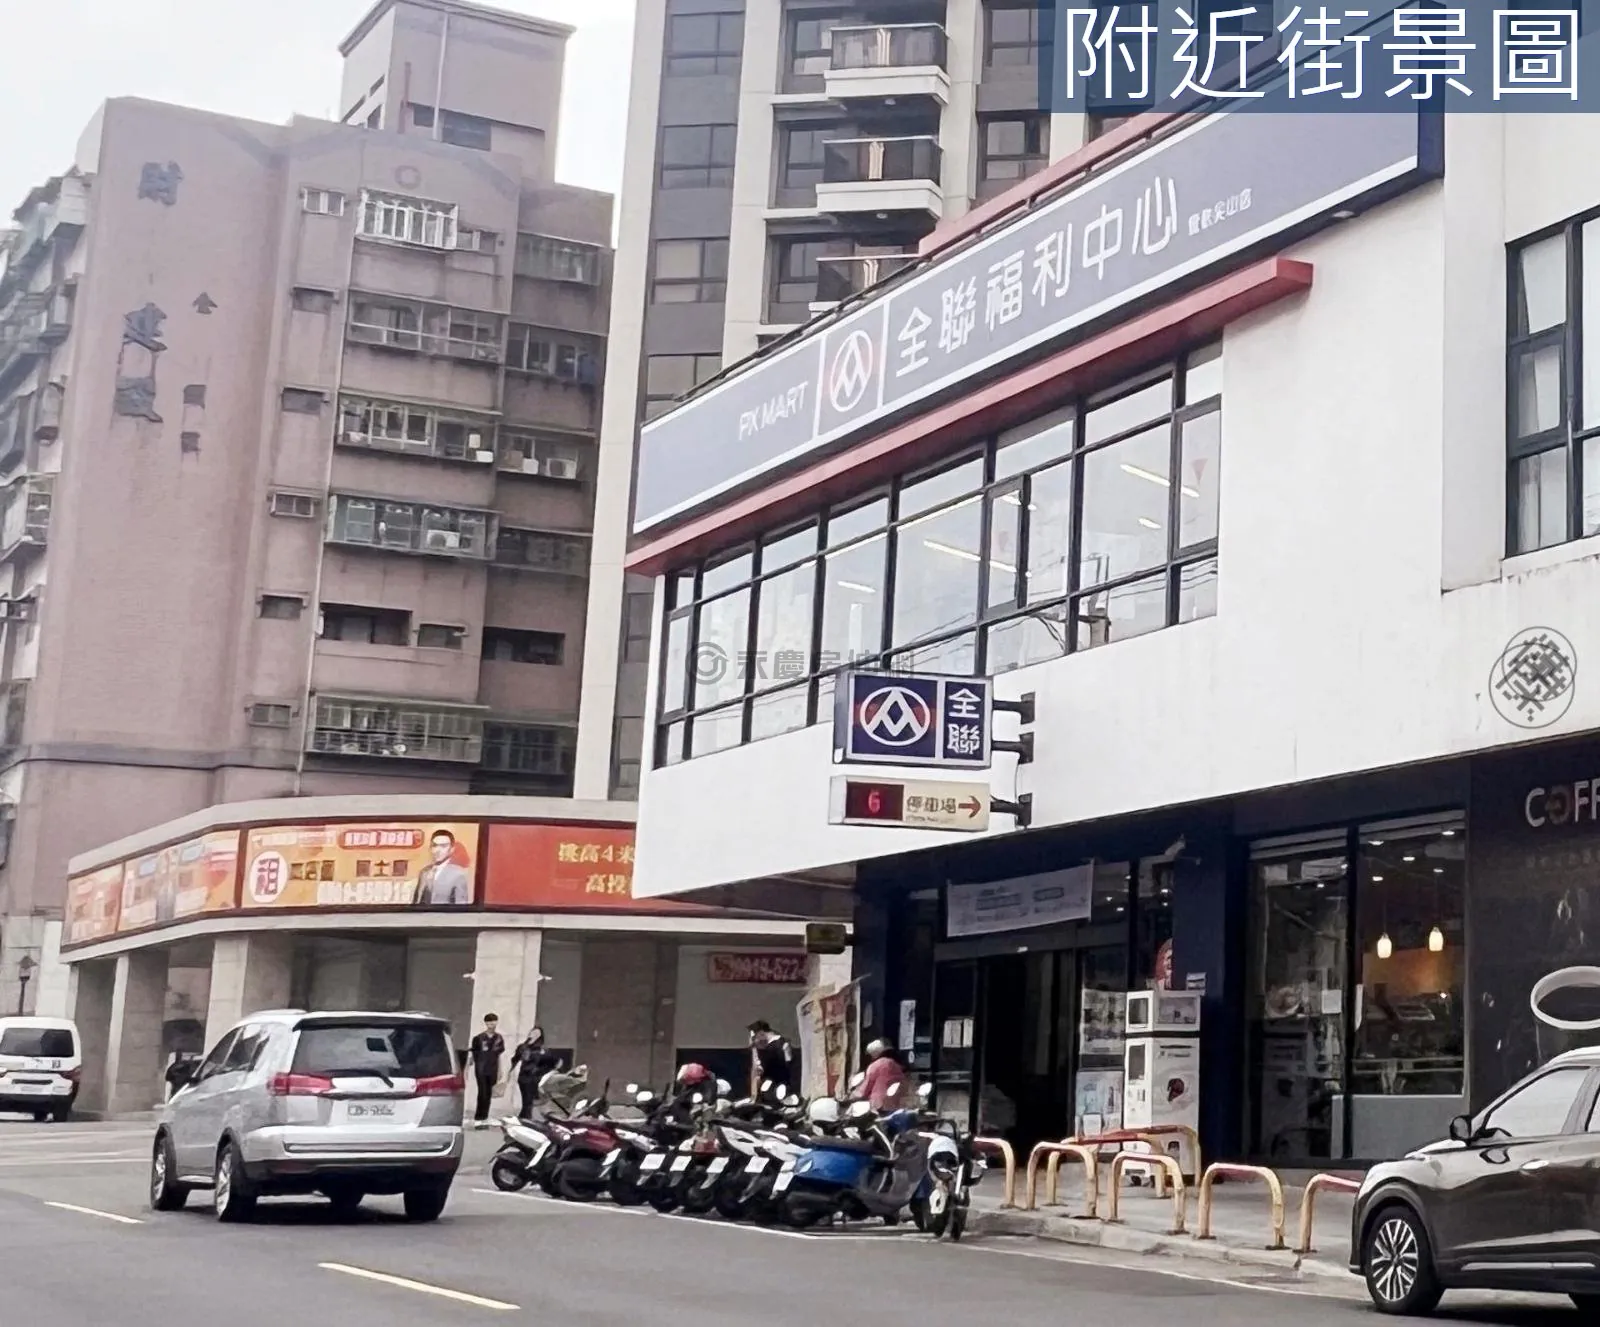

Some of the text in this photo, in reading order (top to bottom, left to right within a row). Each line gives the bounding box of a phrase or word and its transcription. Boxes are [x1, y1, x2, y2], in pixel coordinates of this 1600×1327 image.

[895, 176, 1179, 379] 全聯福利中心
[760, 380, 809, 430] MART
[947, 688, 982, 755] 全聯
[867, 788, 882, 814] 6
